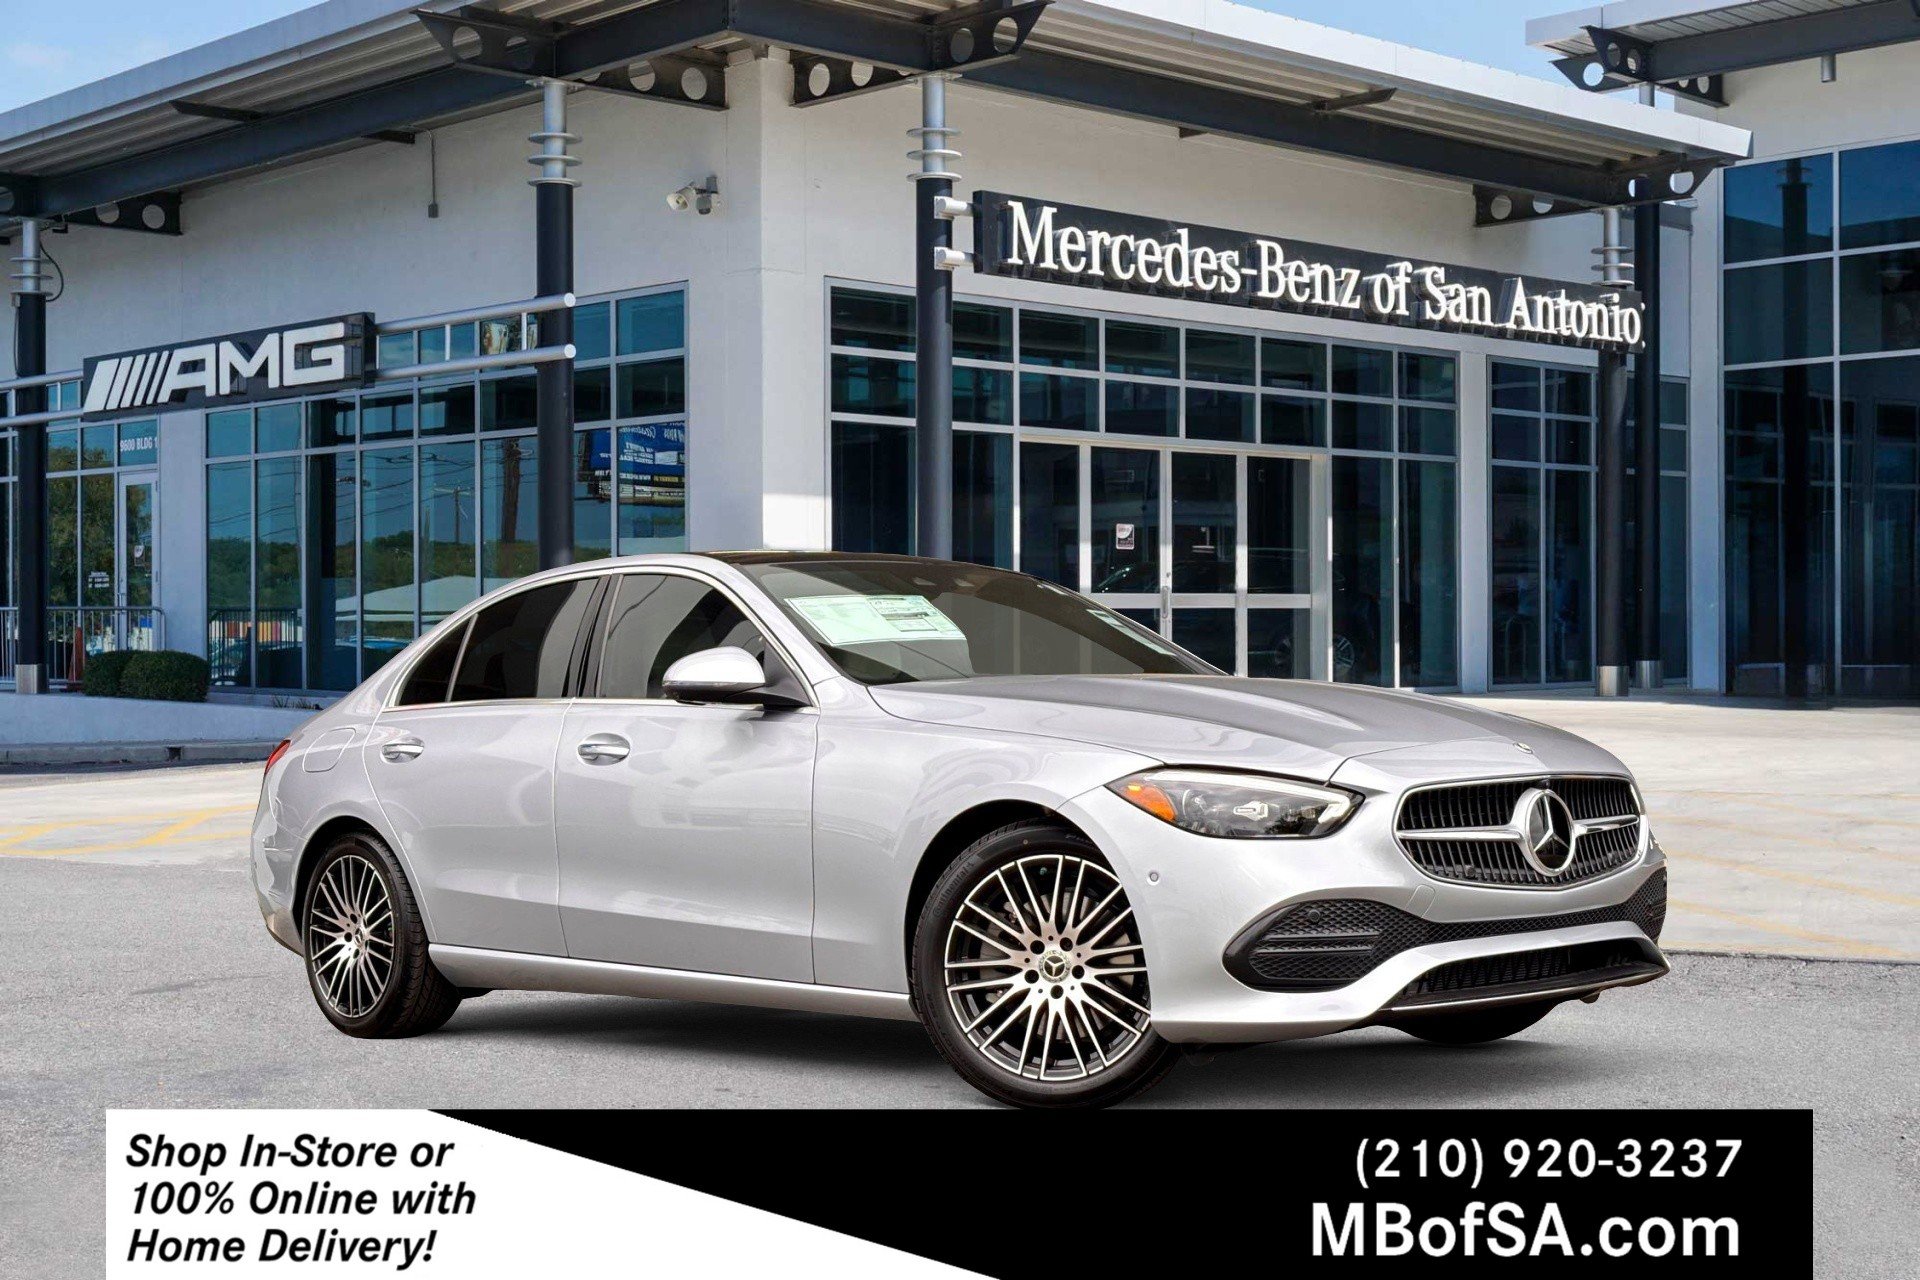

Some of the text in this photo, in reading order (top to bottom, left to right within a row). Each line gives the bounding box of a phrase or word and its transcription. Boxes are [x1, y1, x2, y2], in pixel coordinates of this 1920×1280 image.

[1007, 199, 1642, 345] Mercedes-Benz of San Antonio
[157, 321, 345, 403] AMG
[120, 439, 136, 452] 9600
[136, 437, 153, 450] BLDG
